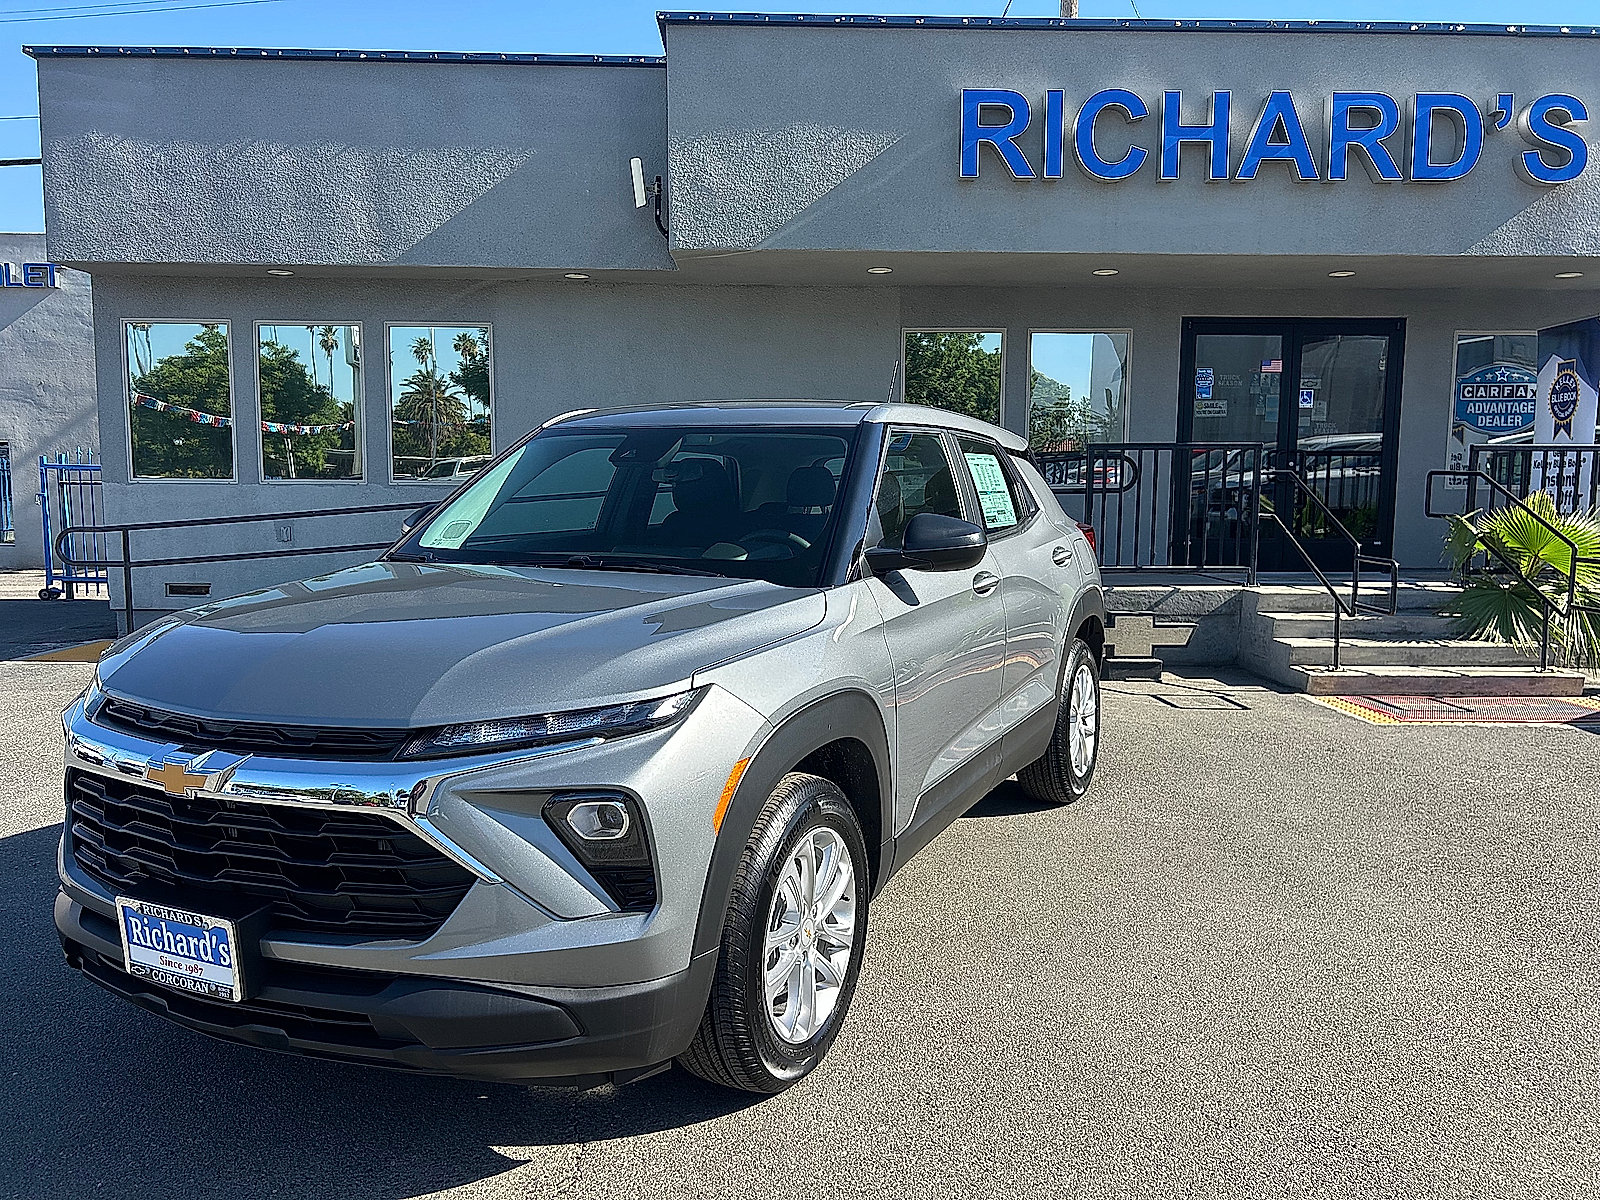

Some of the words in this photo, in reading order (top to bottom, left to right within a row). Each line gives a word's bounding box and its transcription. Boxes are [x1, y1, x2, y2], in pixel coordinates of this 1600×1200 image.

[957, 87, 1589, 184] RICHARD'S
[0, 262, 60, 288] LET
[1466, 402, 1535, 414] ADVANTAGE
[1477, 415, 1523, 427] DEALER
[128, 916, 230, 965] Richard's
[159, 955, 183, 970] Since
[184, 962, 204, 976] 1987
[151, 969, 208, 994] CORCORAN
